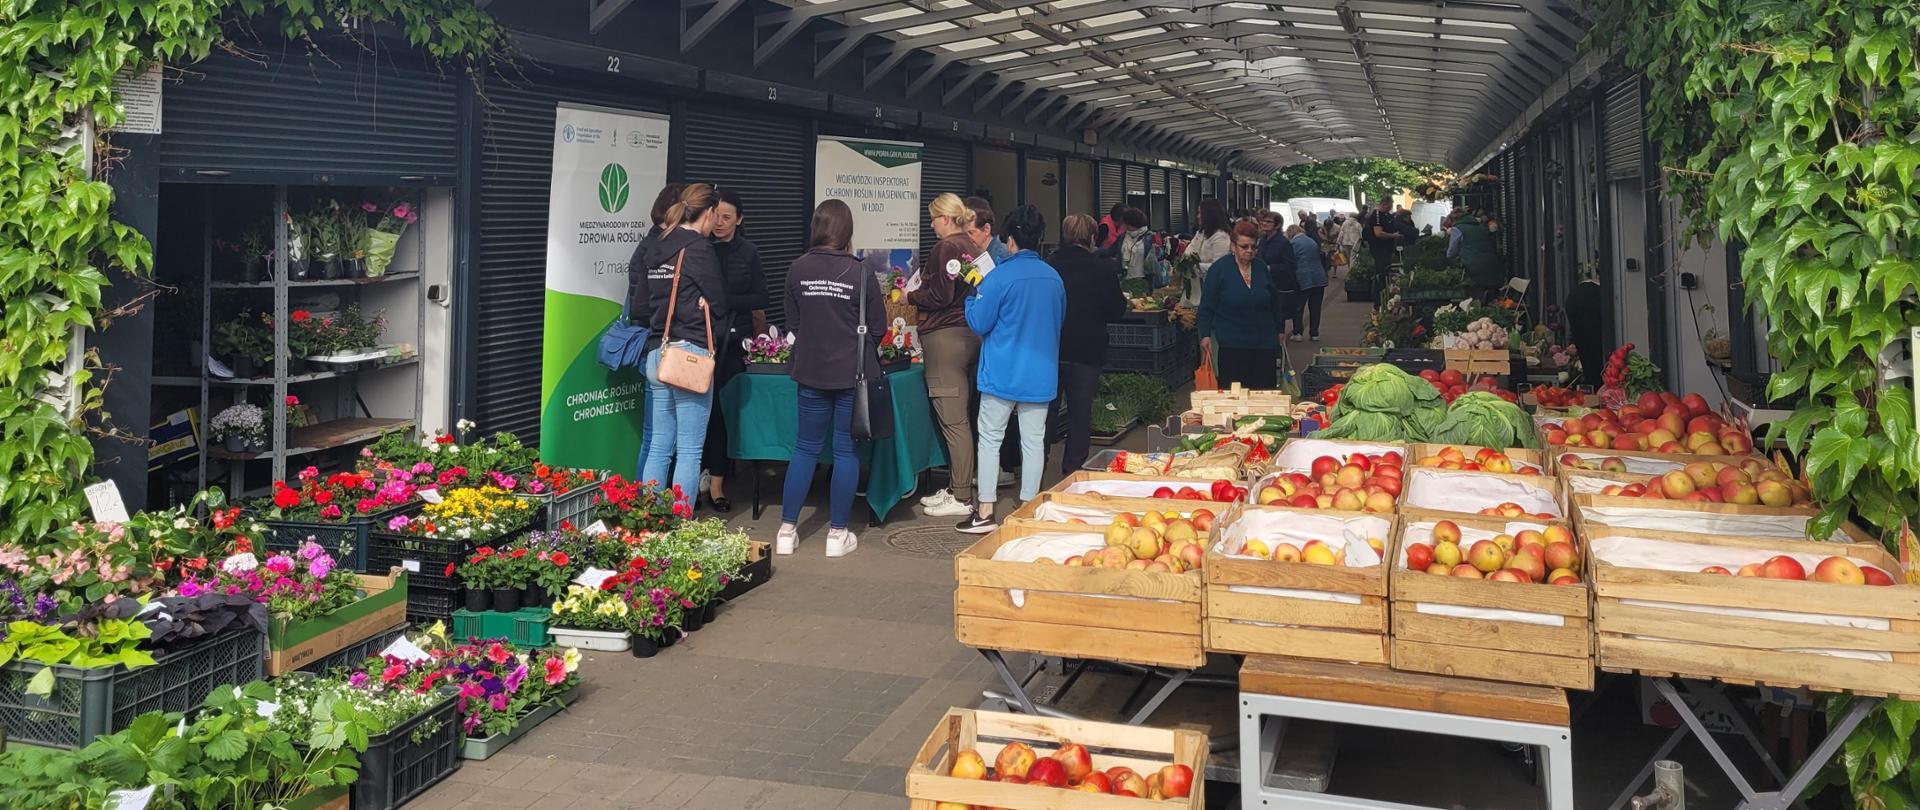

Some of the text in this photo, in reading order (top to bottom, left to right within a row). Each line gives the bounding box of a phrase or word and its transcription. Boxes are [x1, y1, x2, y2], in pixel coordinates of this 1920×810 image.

[607, 56, 620, 73] 22
[768, 87, 777, 101] 23
[875, 106, 882, 119] 24
[861, 203, 868, 212] W
[579, 221, 630, 230] MIĘDZYNARODOWY
[578, 232, 616, 244] ZDROWIA
[593, 260, 630, 276] 12 maja
[566, 388, 609, 407] CHRONIĄC
[573, 399, 636, 422] CHRONISZ ŻYCIE
